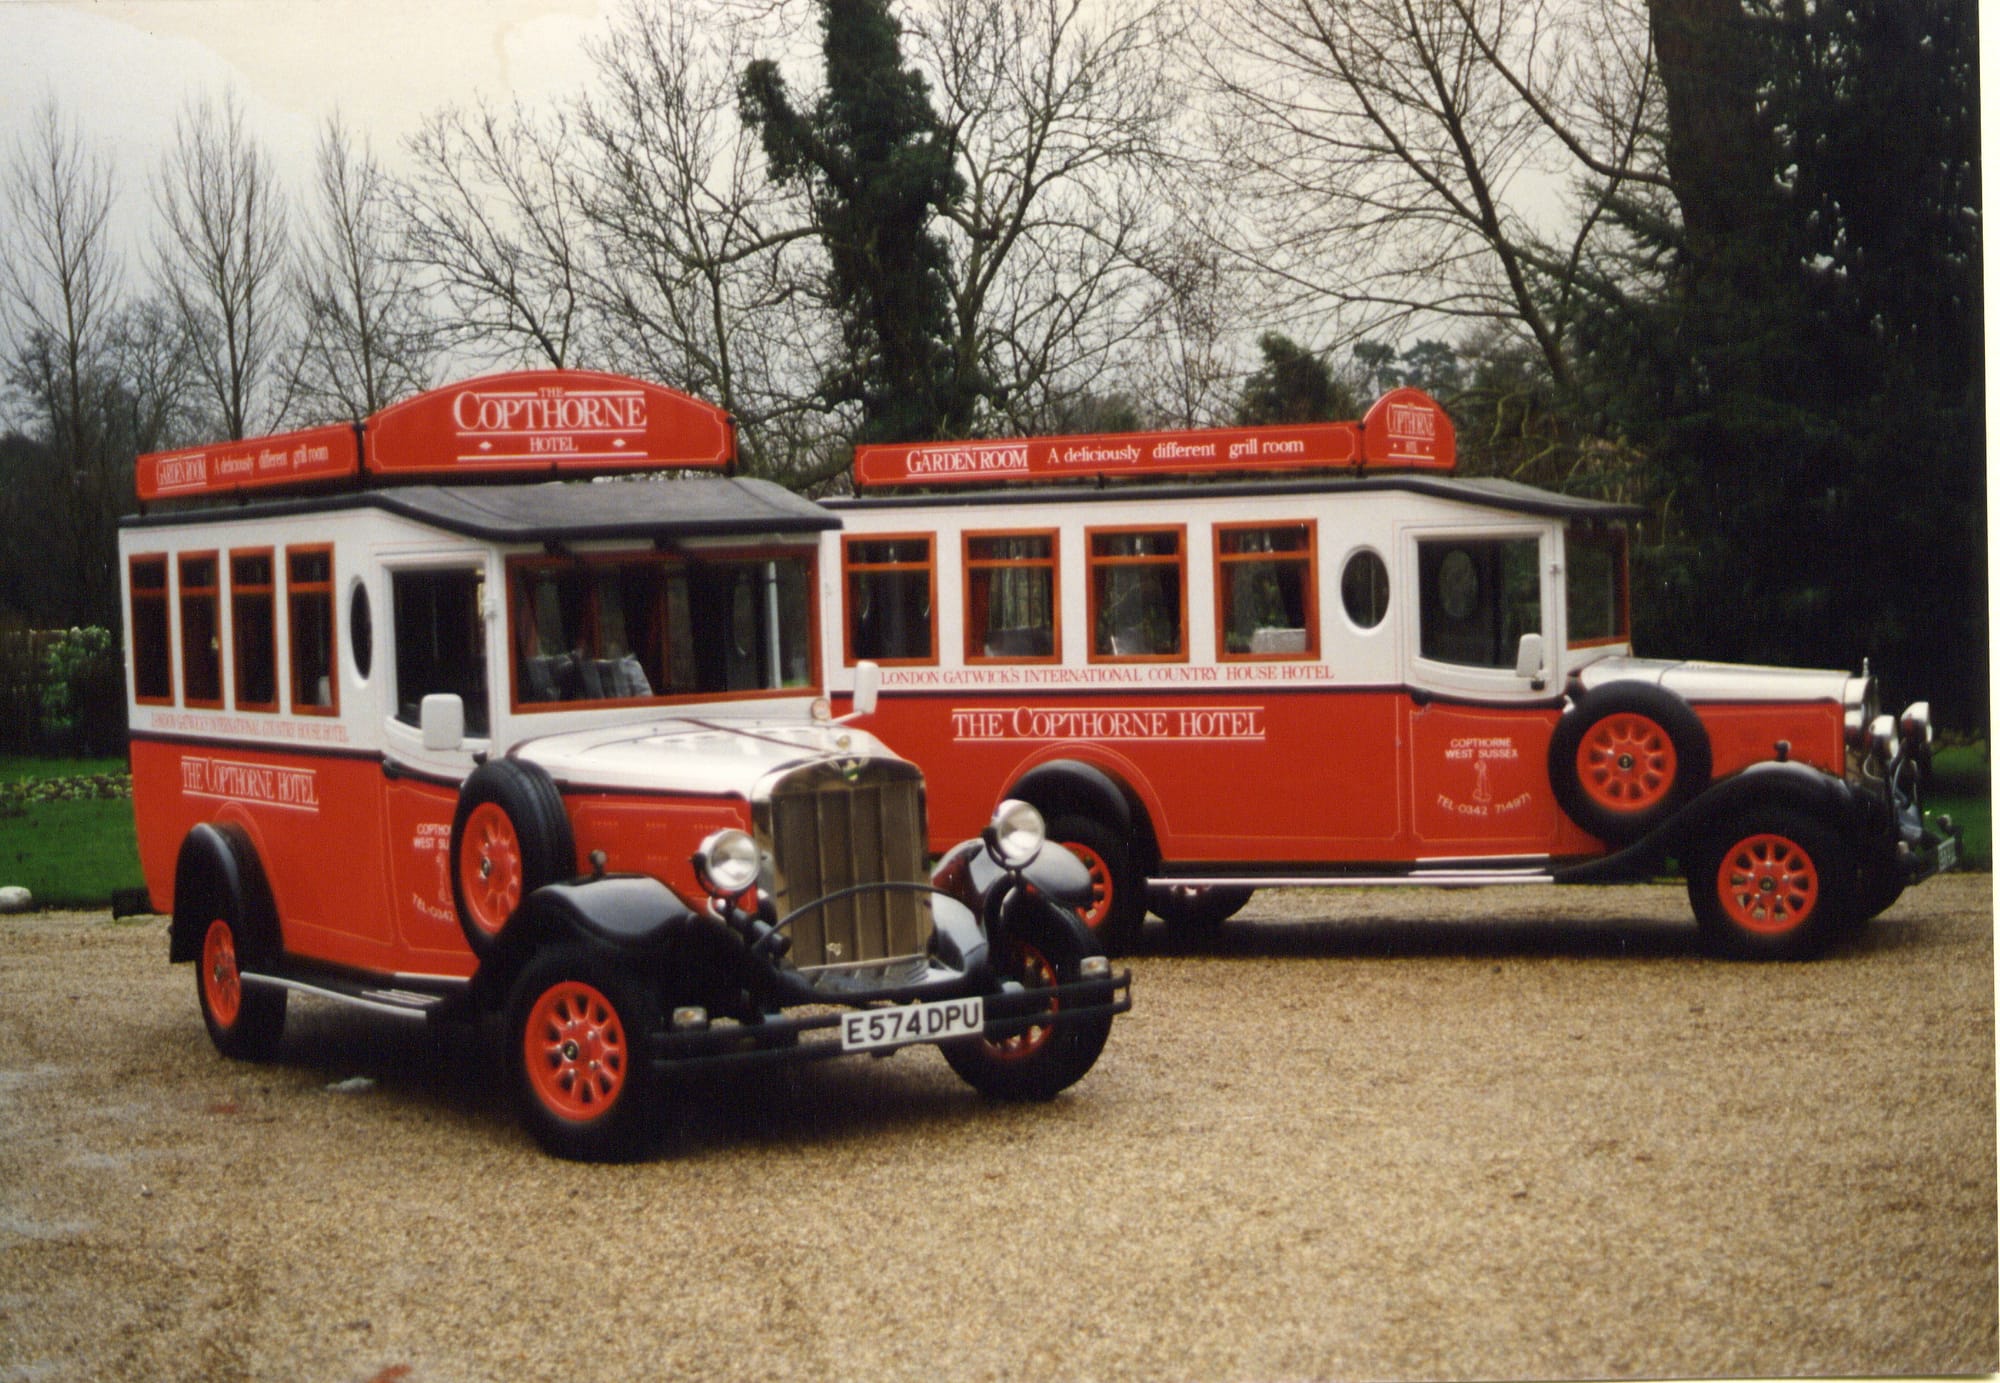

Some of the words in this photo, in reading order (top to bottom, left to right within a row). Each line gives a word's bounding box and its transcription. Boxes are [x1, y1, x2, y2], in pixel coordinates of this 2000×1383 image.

[538, 387, 564, 398] THE
[453, 391, 648, 430] COPTHORNE
[530, 437, 578, 451] HOTEL
[1047, 448, 1059, 463] A
[1064, 444, 1141, 463] deliciously
[1152, 442, 1216, 459] different
[1229, 438, 1258, 459] grill
[1262, 440, 1304, 454] room
[906, 450, 976, 473] GARDEN
[980, 449, 1029, 469] ROOM
[881, 671, 939, 685] LONDON
[1024, 667, 1142, 683] INTERNATIONAL
[1148, 666, 1220, 682] COUNTRY
[1226, 665, 1278, 681] HOUSE
[1282, 665, 1335, 680] HOTEL
[952, 713, 1003, 737] THE
[1012, 706, 1168, 737] COPTHORNE
[1180, 712, 1266, 736] HOTEL
[1450, 737, 1511, 748] COPTHORNE
[1444, 749, 1473, 759] WEST
[1478, 749, 1519, 759] SUSSEX
[181, 761, 203, 790] THE
[205, 757, 275, 799] COPTHORNE
[277, 771, 319, 805] HOTEL
[417, 823, 452, 835] COPTHO
[413, 837, 435, 849] WEST
